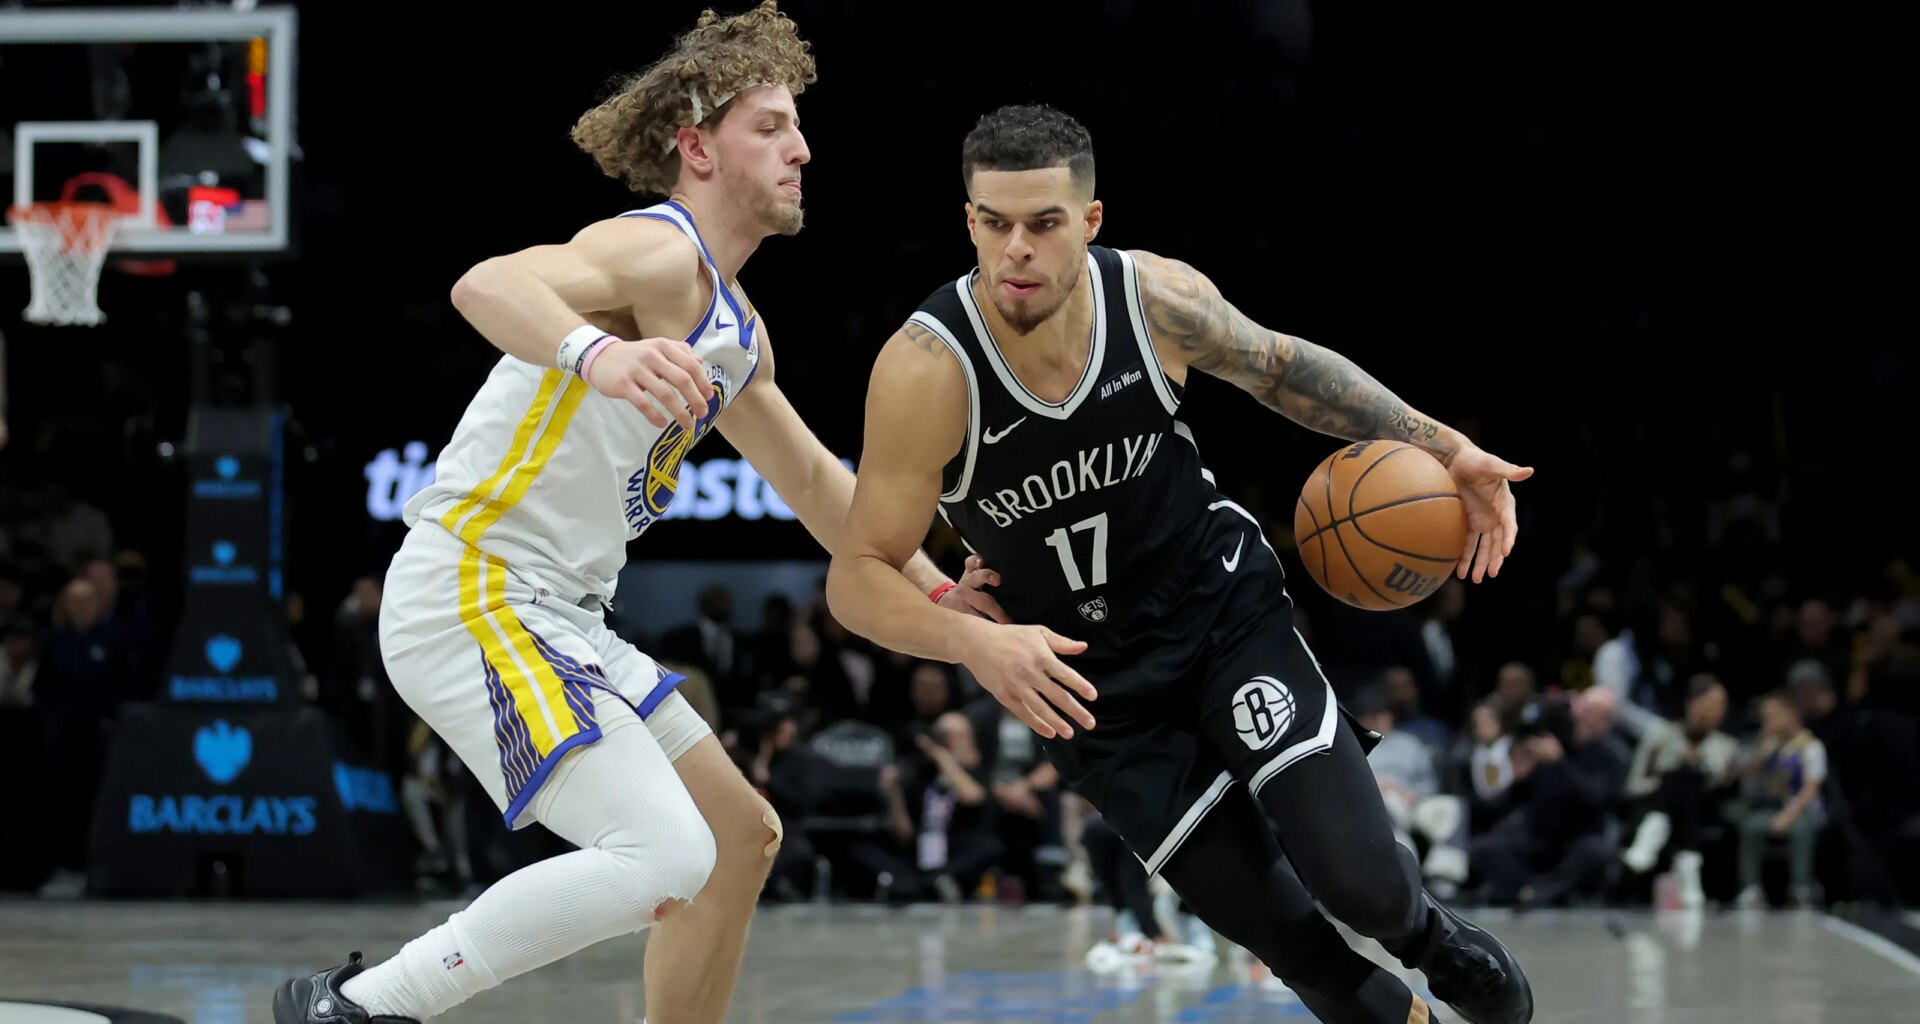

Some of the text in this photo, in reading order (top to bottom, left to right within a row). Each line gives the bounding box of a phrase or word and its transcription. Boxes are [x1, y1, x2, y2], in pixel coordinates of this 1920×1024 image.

[1101, 382, 1113, 400] All
[1112, 379, 1123, 393] In
[625, 466, 651, 533] WARR
[977, 432, 1163, 527] BROOKLYN
[1044, 511, 1109, 592] 17
[1384, 562, 1440, 597] Wil
[1081, 598, 1104, 616] NETS
[1244, 687, 1274, 741] B
[129, 794, 317, 835] BARCLAYS
